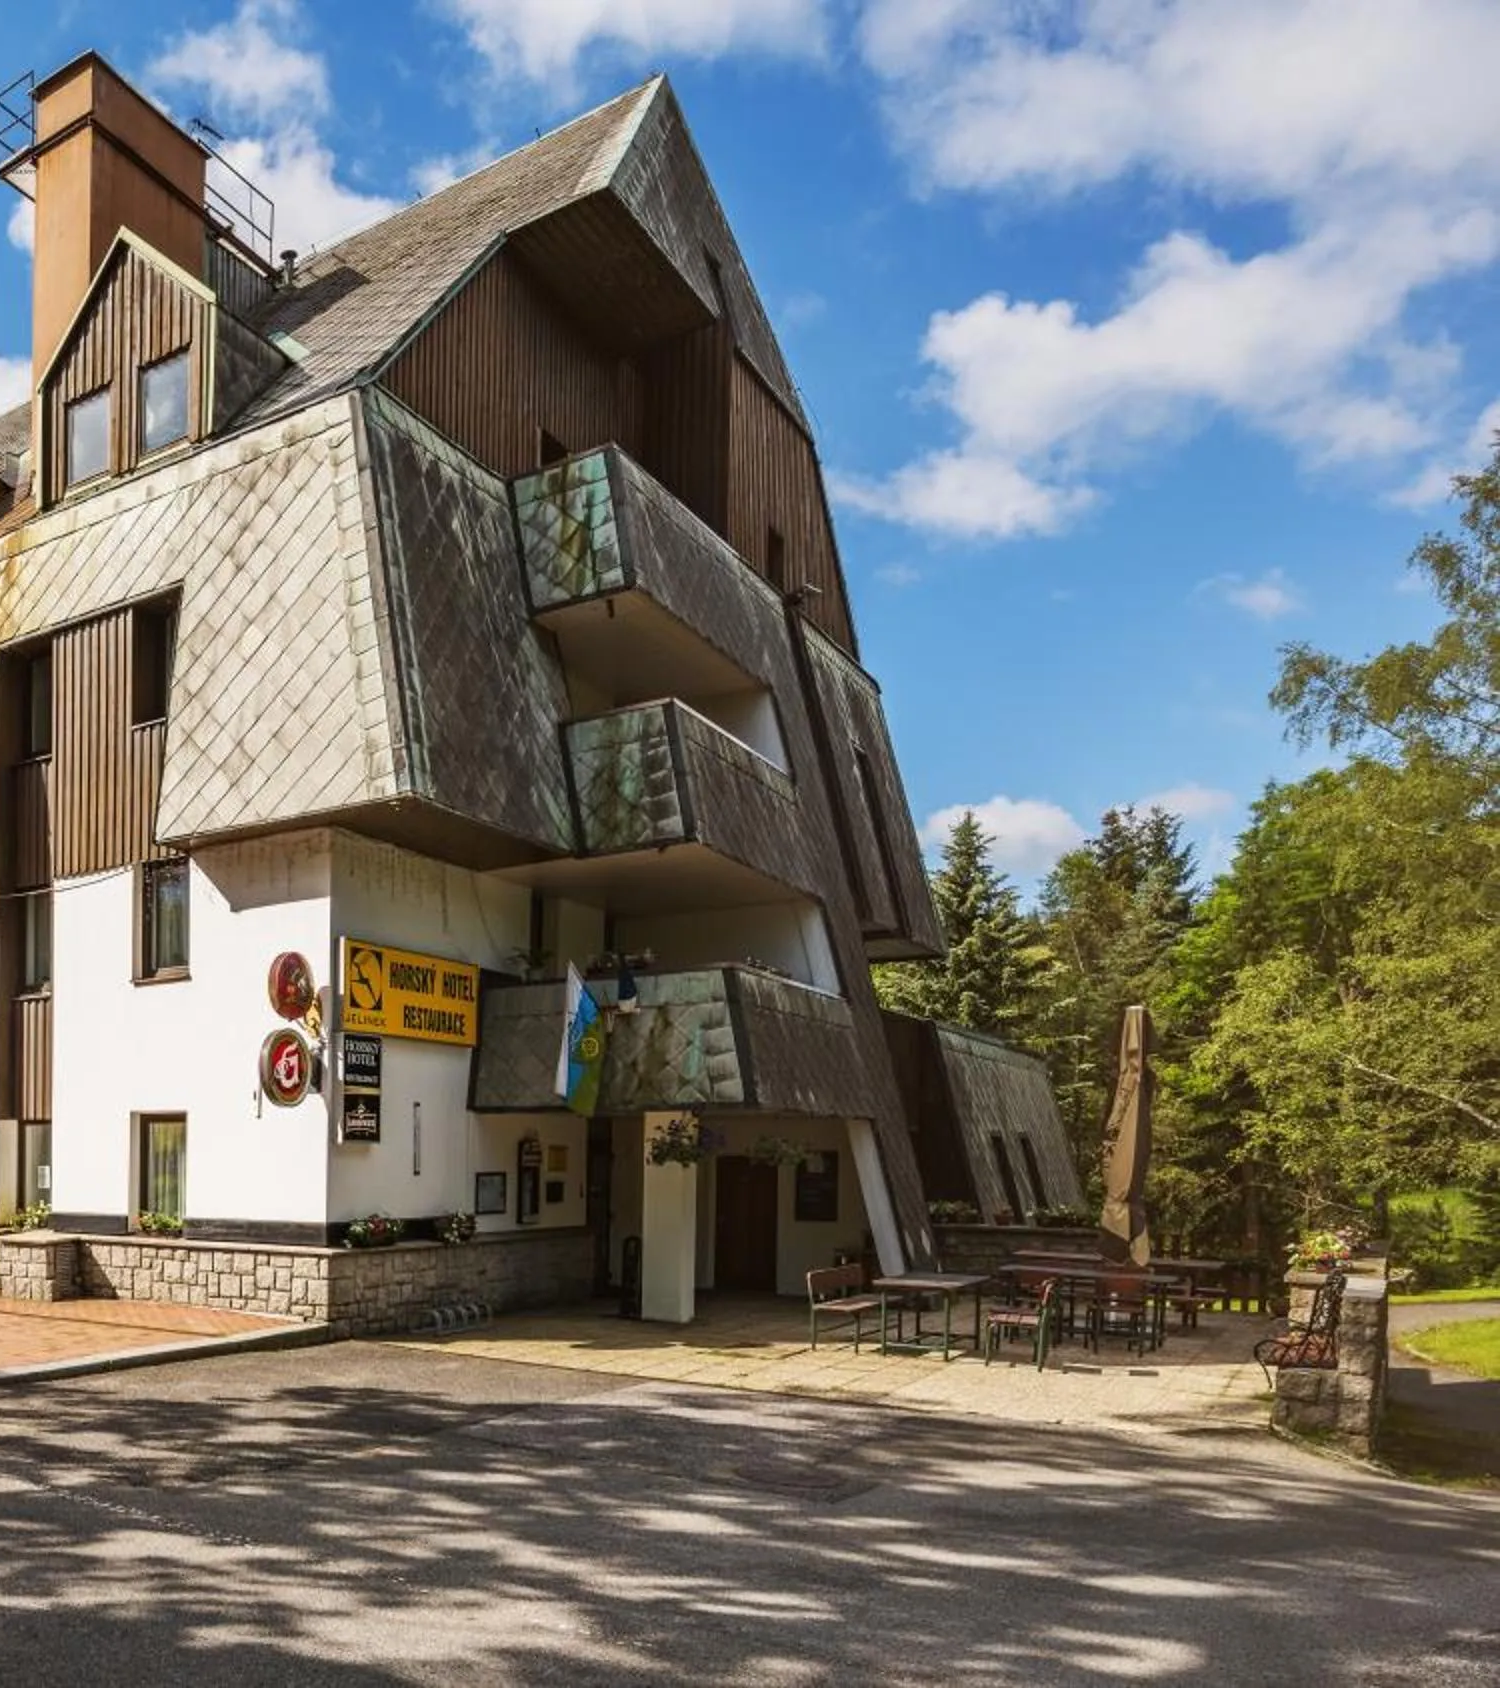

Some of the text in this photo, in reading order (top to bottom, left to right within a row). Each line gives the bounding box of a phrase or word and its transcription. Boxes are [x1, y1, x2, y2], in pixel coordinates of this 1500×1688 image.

[389, 963, 475, 1002] HORSKÝ HOTEL
[403, 1005, 465, 1037] RESTAURACE
